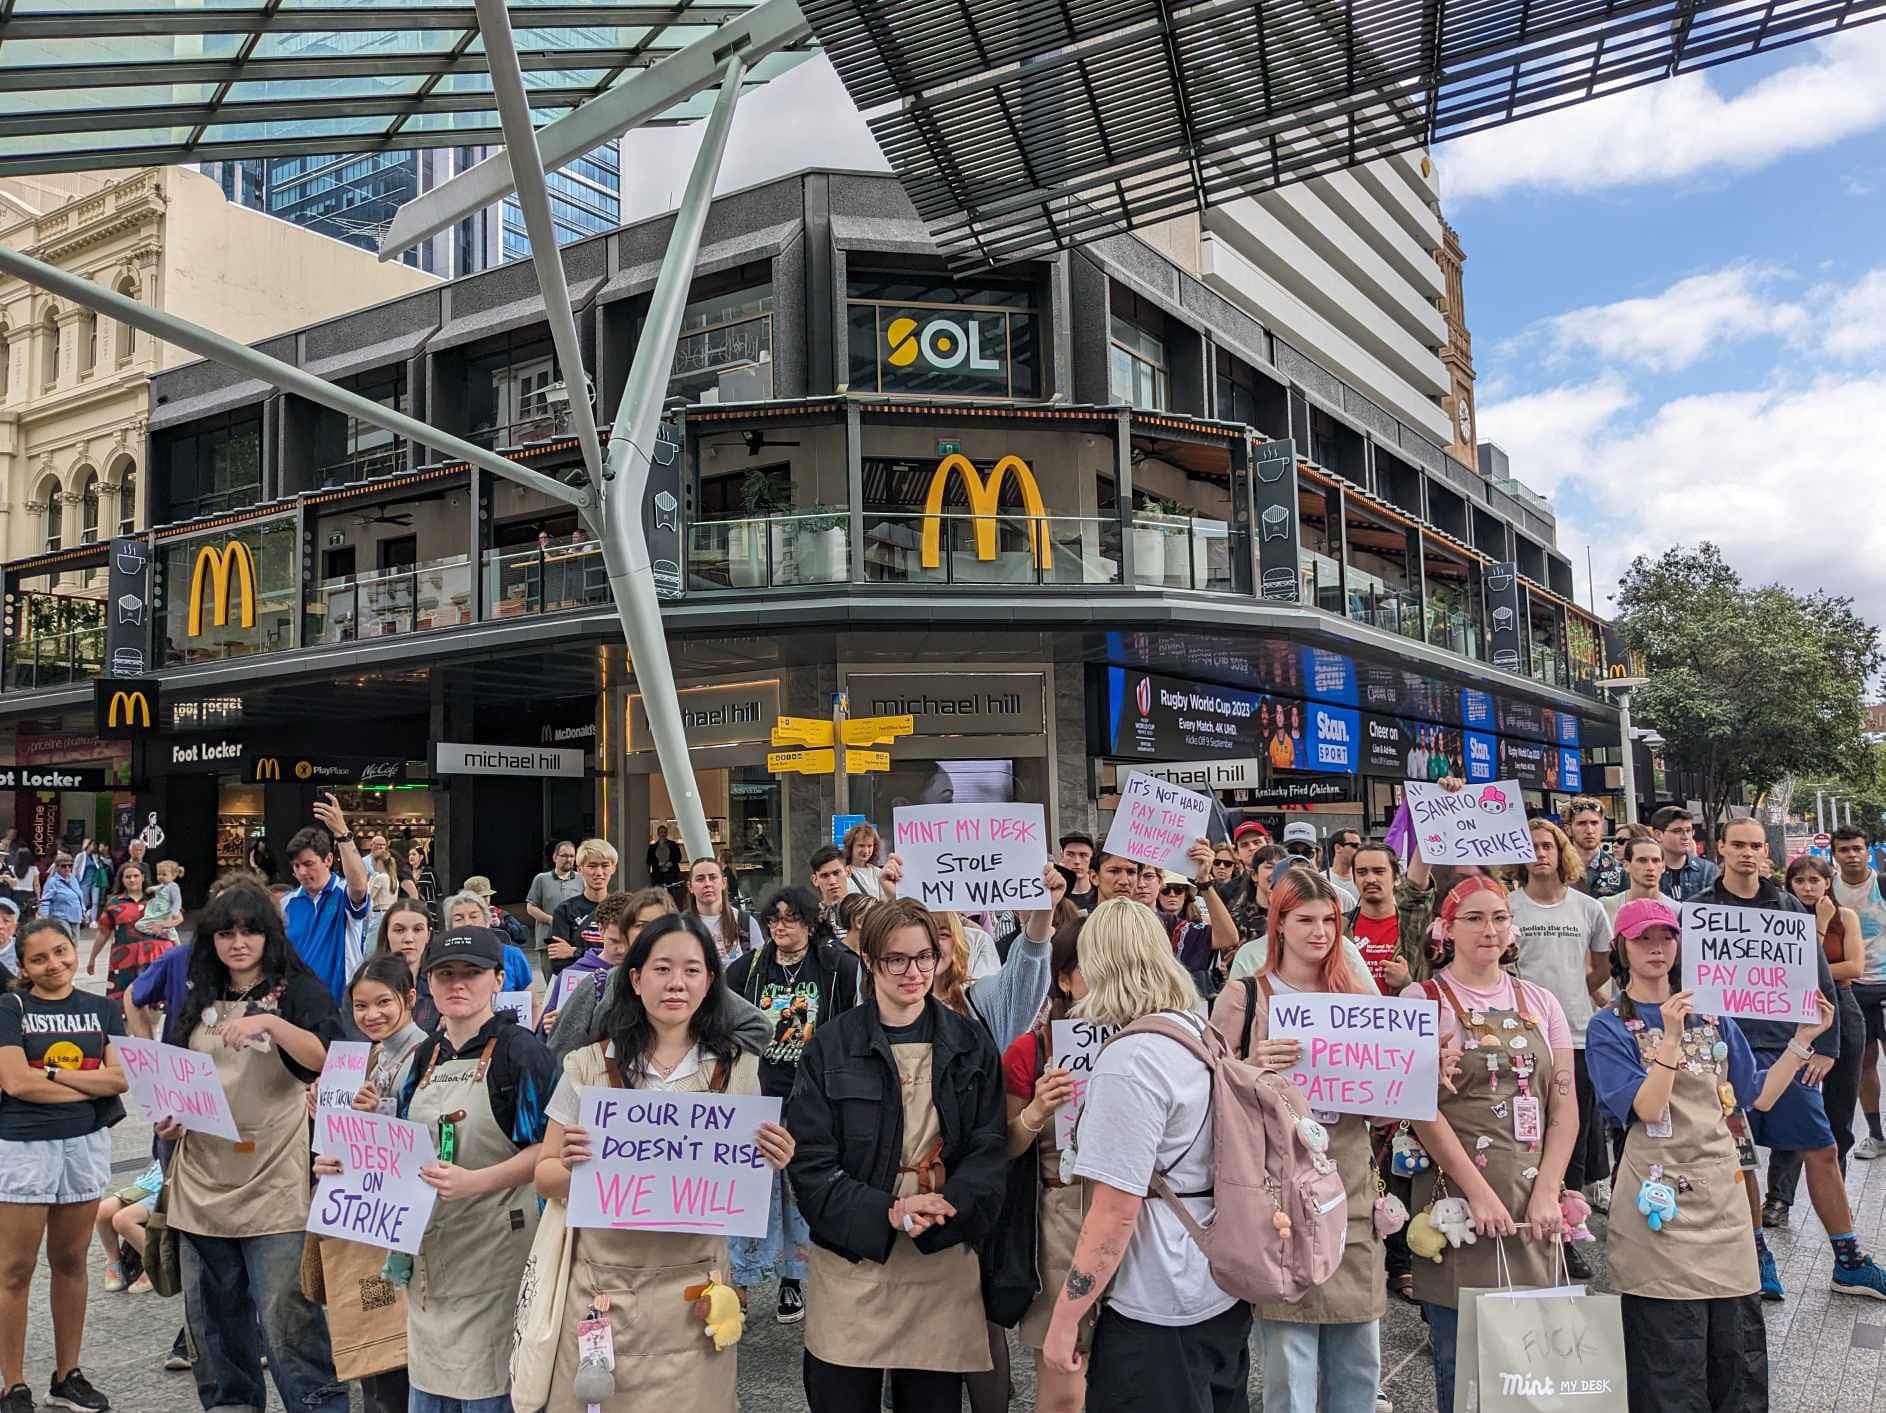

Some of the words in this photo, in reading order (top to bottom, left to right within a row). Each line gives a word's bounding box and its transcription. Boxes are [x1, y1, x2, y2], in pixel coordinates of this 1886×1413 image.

[887, 317, 1000, 370] SOL
[731, 701, 761, 722] hill
[872, 694, 979, 715] michael
[986, 694, 1021, 714] hill
[1160, 689, 1188, 711] Rugby
[1189, 693, 1214, 713] World
[1215, 698, 1231, 716] Cup
[1231, 701, 1250, 717] 2023
[1178, 718, 1195, 733] Every
[1369, 720, 1389, 739] Cheer
[1389, 727, 1399, 740] on
[172, 746, 198, 763] Foot
[201, 742, 242, 761] Locker
[464, 751, 535, 769] michael
[539, 753, 561, 770] hill
[1319, 745, 1347, 763] SPORT
[22, 770, 83, 787] Locker
[1146, 766, 1211, 784] ichael
[1217, 765, 1245, 782] hill
[1128, 777, 1150, 797] IT'S
[1155, 785, 1179, 807] NOT
[1255, 785, 1288, 799] Kentucky
[1289, 784, 1308, 798] Fried
[1309, 783, 1340, 797] Chicken
[1131, 801, 1156, 819] PAY
[1160, 809, 1185, 827] THE
[1414, 794, 1476, 824] SANRIO
[896, 820, 949, 845] MINT
[955, 818, 982, 843] MY
[989, 816, 1037, 843] DESK
[1129, 820, 1185, 849] MINIMUM
[1456, 818, 1477, 831] ON
[1454, 828, 1531, 858] STRIKE!
[936, 852, 1003, 874] STOLE
[922, 880, 954, 904] MY
[965, 877, 1045, 905] WAGES
[1690, 907, 1751, 934] SELL
[1760, 912, 1807, 941] YOUR
[1701, 937, 1802, 966] MASERATI
[1697, 964, 1738, 987] PAY
[1747, 966, 1788, 989] OUR
[1722, 989, 1792, 1015] WAGES
[22, 1013, 101, 1033] AUSTRALIA
[1275, 1005, 1314, 1028] WE
[1331, 1005, 1434, 1037] DESERVE
[120, 1047, 160, 1078] PAY
[170, 1055, 196, 1083] UP
[1311, 1038, 1415, 1075] PENALTY
[595, 1100, 618, 1129] IF
[627, 1102, 679, 1127] OUR
[691, 1103, 736, 1130] PAY
[326, 1114, 378, 1143] MINT
[388, 1122, 415, 1152] MY
[350, 1143, 401, 1178] DESK
[601, 1134, 703, 1162] DOESN'T
[714, 1142, 765, 1169] RISE
[363, 1172, 384, 1193] ON
[594, 1171, 657, 1217] WE
[672, 1175, 745, 1217] WILL
[322, 1188, 409, 1243] STRIKE
[1521, 1322, 1601, 1364] FUCK
[1560, 1380, 1576, 1392] MY
[1581, 1379, 1613, 1394] DESK
